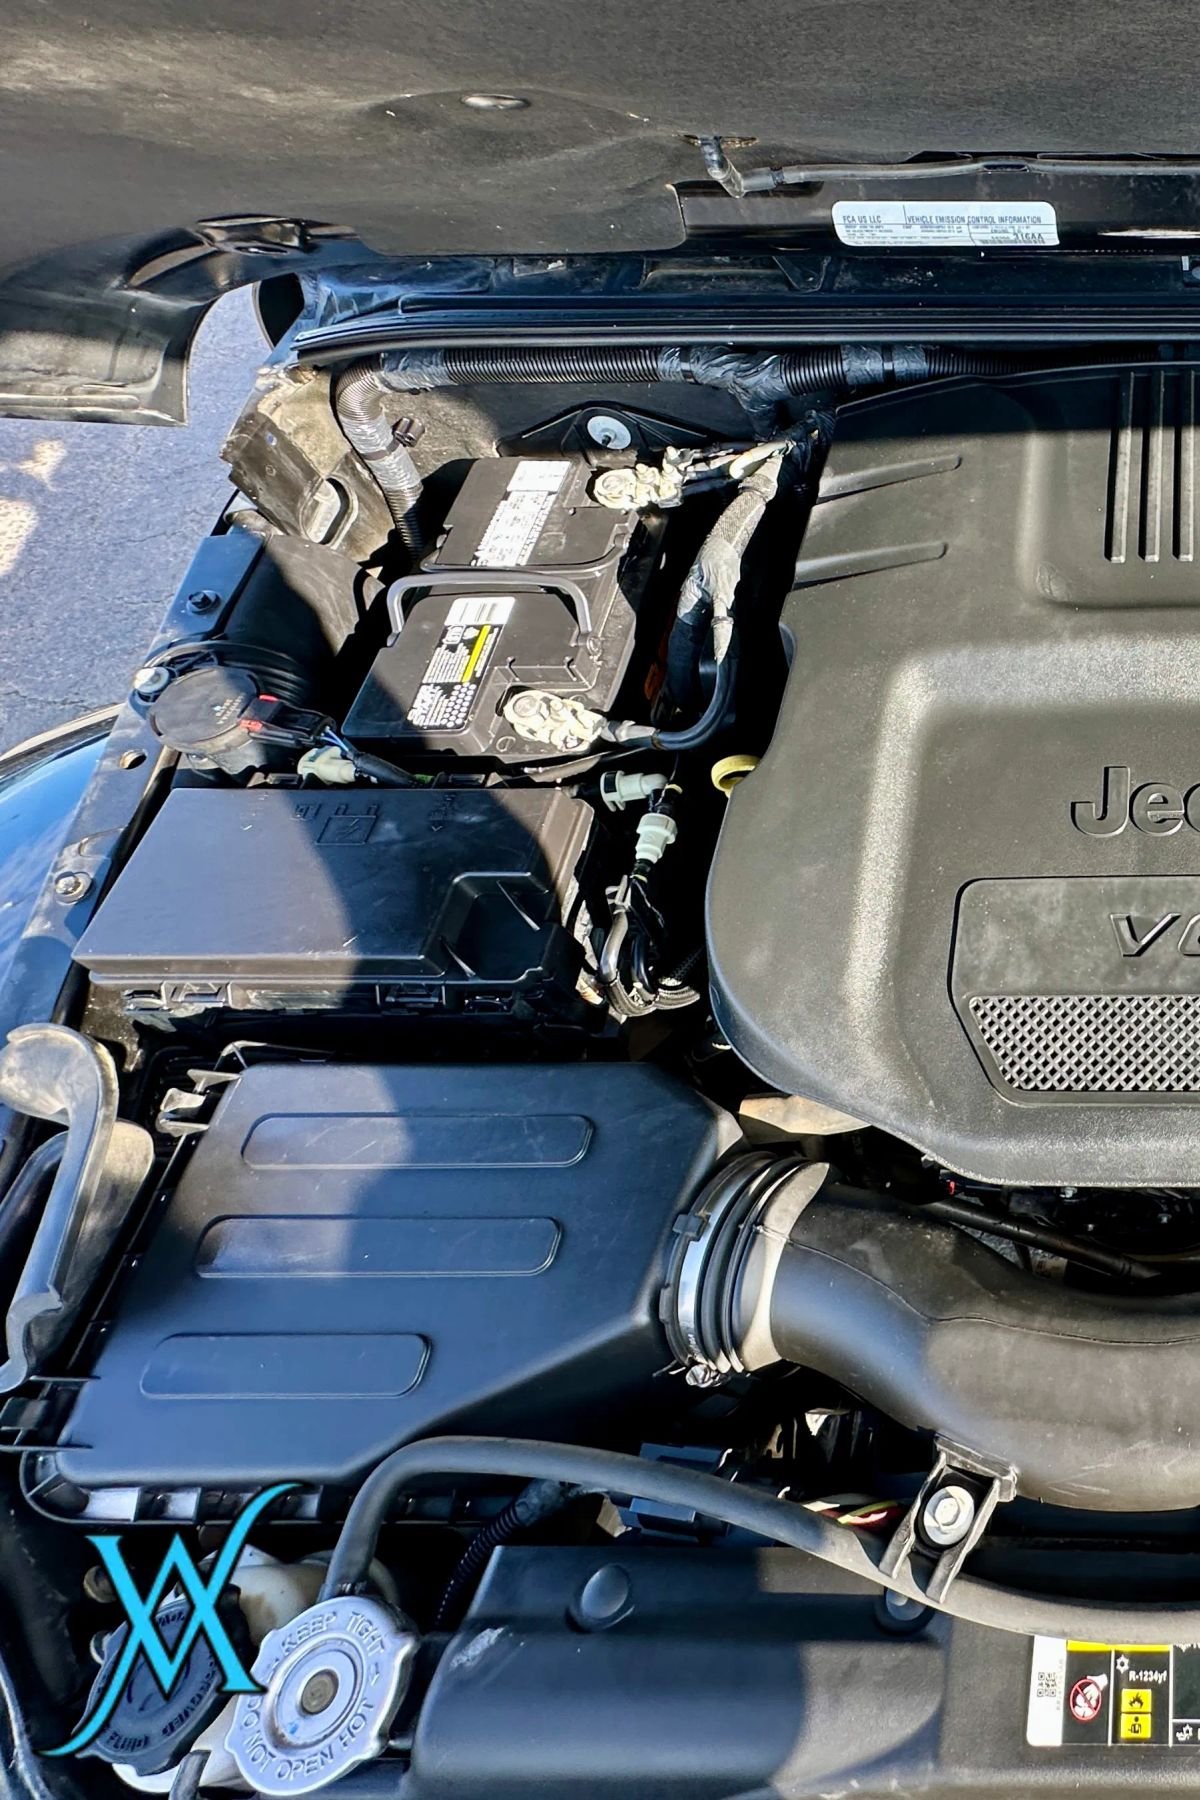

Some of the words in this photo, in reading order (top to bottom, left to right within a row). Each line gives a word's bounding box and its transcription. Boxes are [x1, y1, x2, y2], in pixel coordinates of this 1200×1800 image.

[842, 214, 857, 224] FCA
[857, 214, 868, 224] US
[868, 214, 882, 224] LLC
[907, 215, 933, 224] VEHICLE
[935, 215, 966, 224] EMISSION
[967, 215, 996, 224] CONTROL
[998, 215, 1042, 224] INFORMATION
[280, 1610, 338, 1655] KEEP
[346, 1610, 386, 1657] TIGHT
[1128, 1669, 1168, 1684] R-1234yf
[243, 1729, 278, 1774] NOT
[276, 1745, 335, 1782] OPEN
[338, 1696, 375, 1750] HOT
